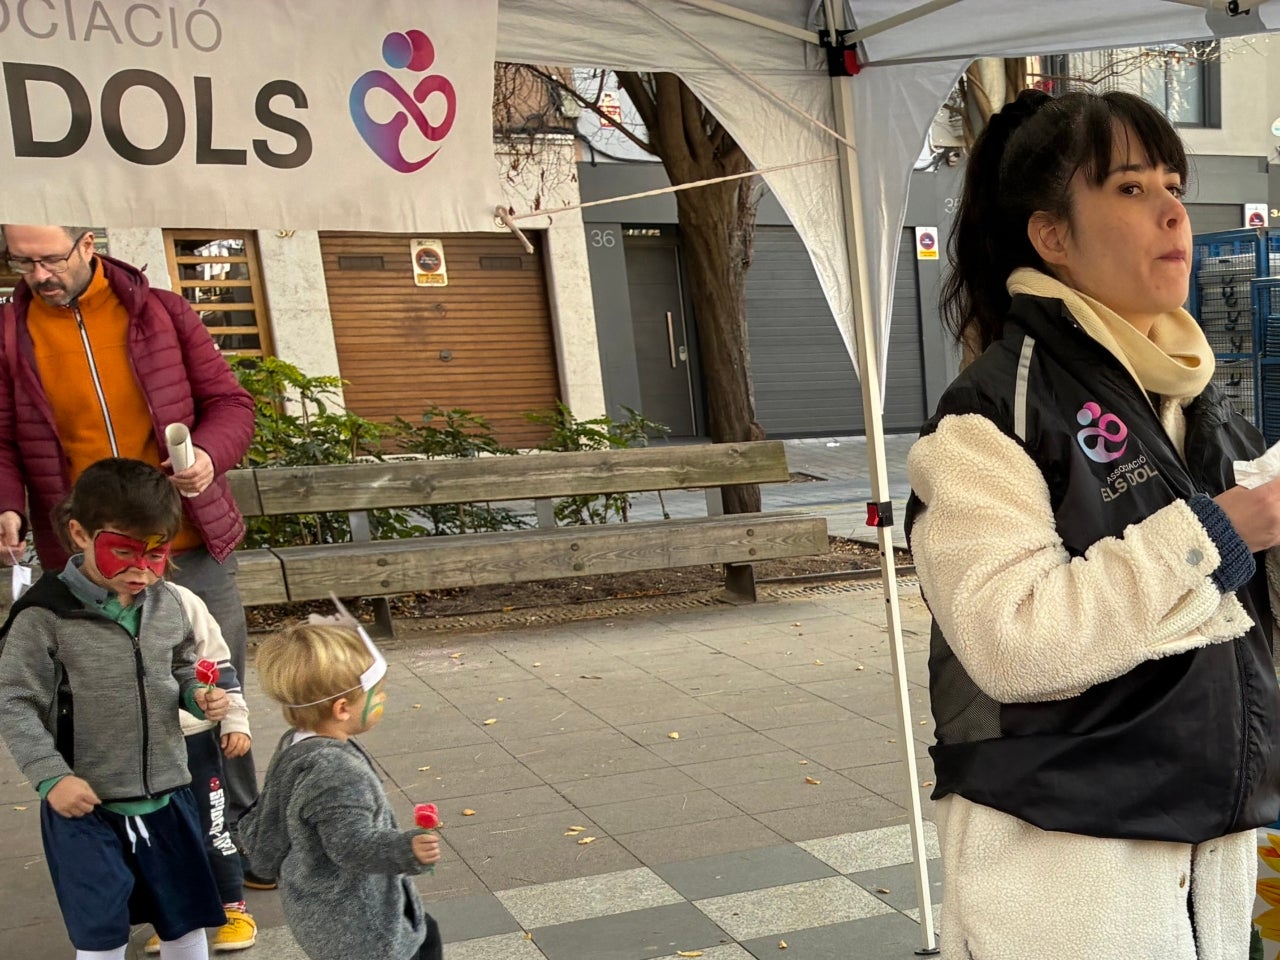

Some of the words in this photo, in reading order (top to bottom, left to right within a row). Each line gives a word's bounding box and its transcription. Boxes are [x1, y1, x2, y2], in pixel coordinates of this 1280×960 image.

[0, 0, 222, 52] CIACIÓ
[2, 61, 313, 169] DOLS
[590, 229, 616, 248] 36
[1106, 455, 1147, 484] ASSOCIACIÓ
[1100, 478, 1127, 502] ELS
